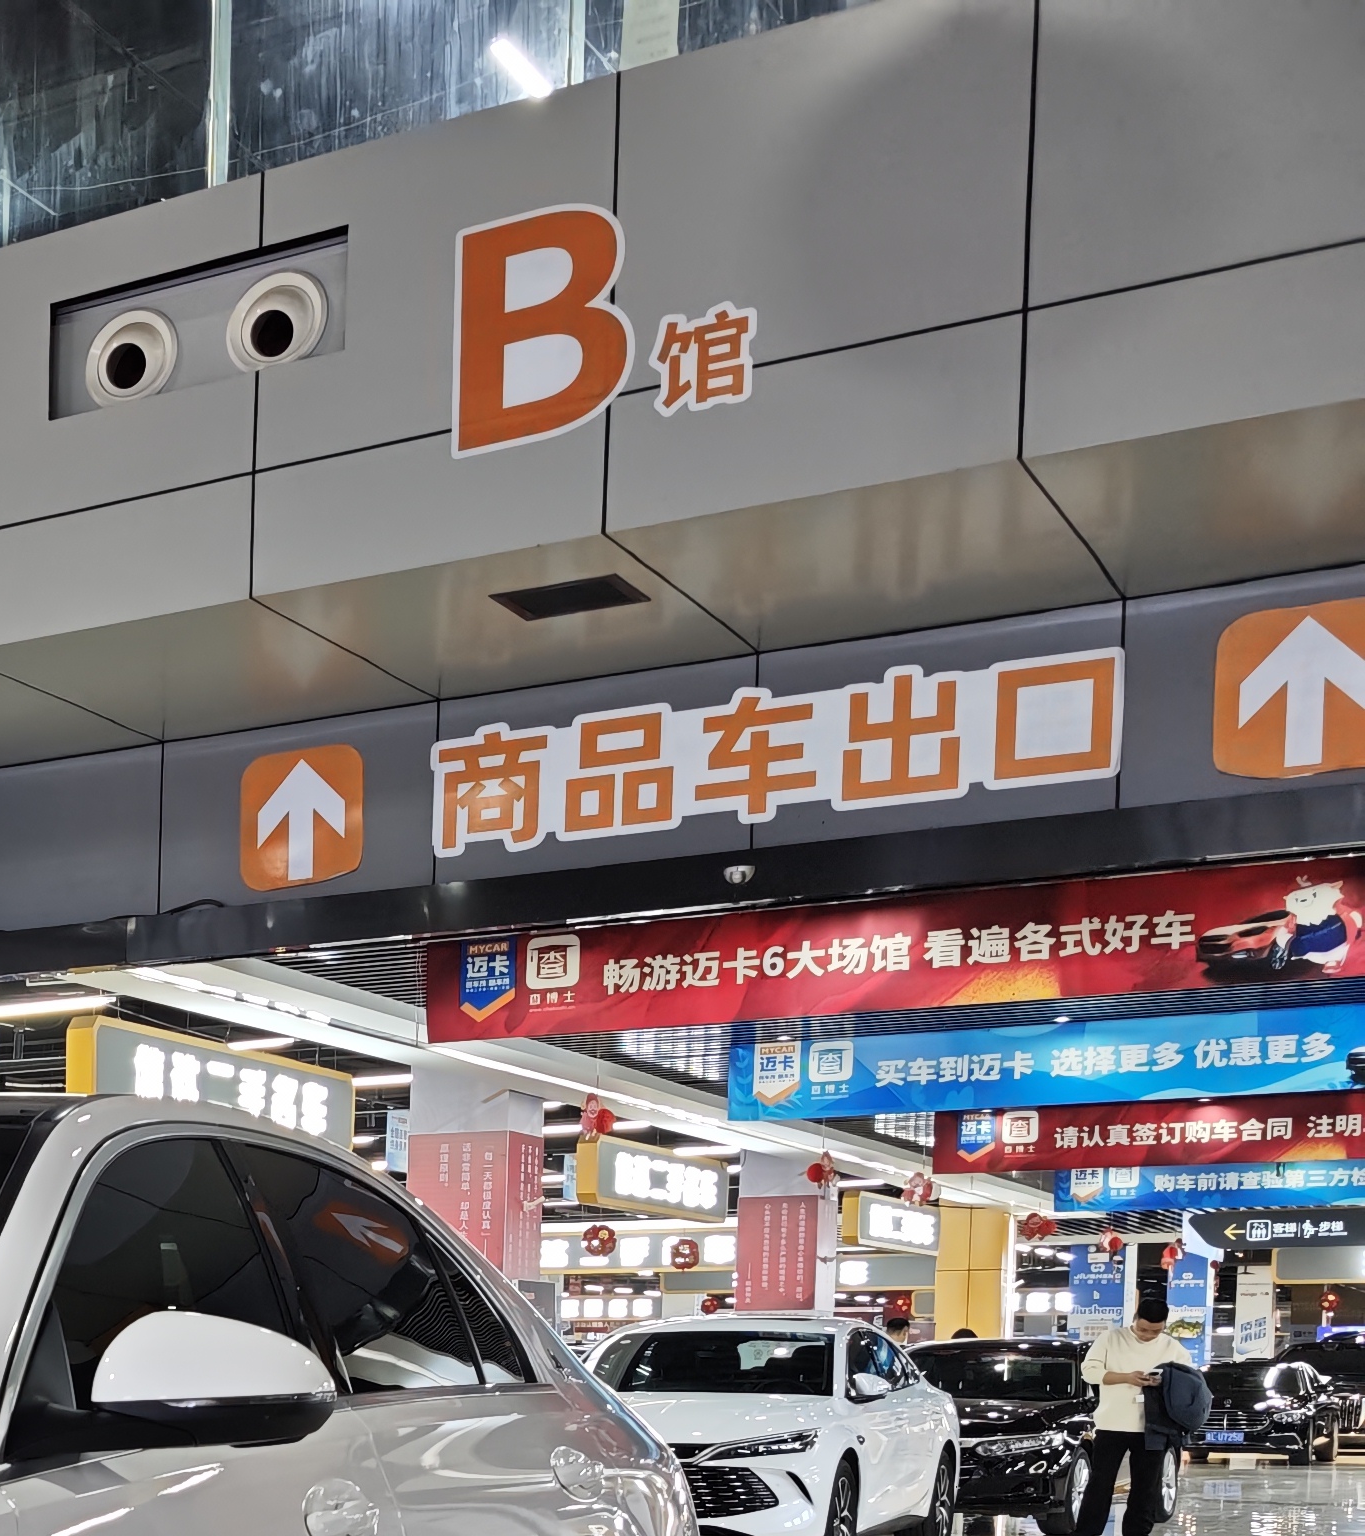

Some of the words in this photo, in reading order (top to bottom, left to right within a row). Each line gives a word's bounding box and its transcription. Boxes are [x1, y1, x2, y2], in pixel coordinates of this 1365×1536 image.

[457, 207, 751, 454] B馆
[437, 654, 1118, 851] 商品车出口
[469, 942, 508, 954] MYCAR
[602, 932, 911, 996] 畅游迈卡6大场馆
[922, 909, 1197, 968] 看遍各式好车
[466, 955, 510, 978] 迈卡
[761, 1046, 794, 1054] MYCAR
[875, 1054, 1035, 1088] 买车到迈卡
[1050, 1041, 1183, 1078] 选择更多
[1194, 1031, 1337, 1069] 优惠更多
[759, 1055, 795, 1072] 迈卡
[961, 1121, 991, 1135] 迈卡
[1053, 1117, 1293, 1149] 请认真签订购车合同
[1306, 1113, 1365, 1139] 注明
[1074, 1169, 1100, 1181] 迈卡
